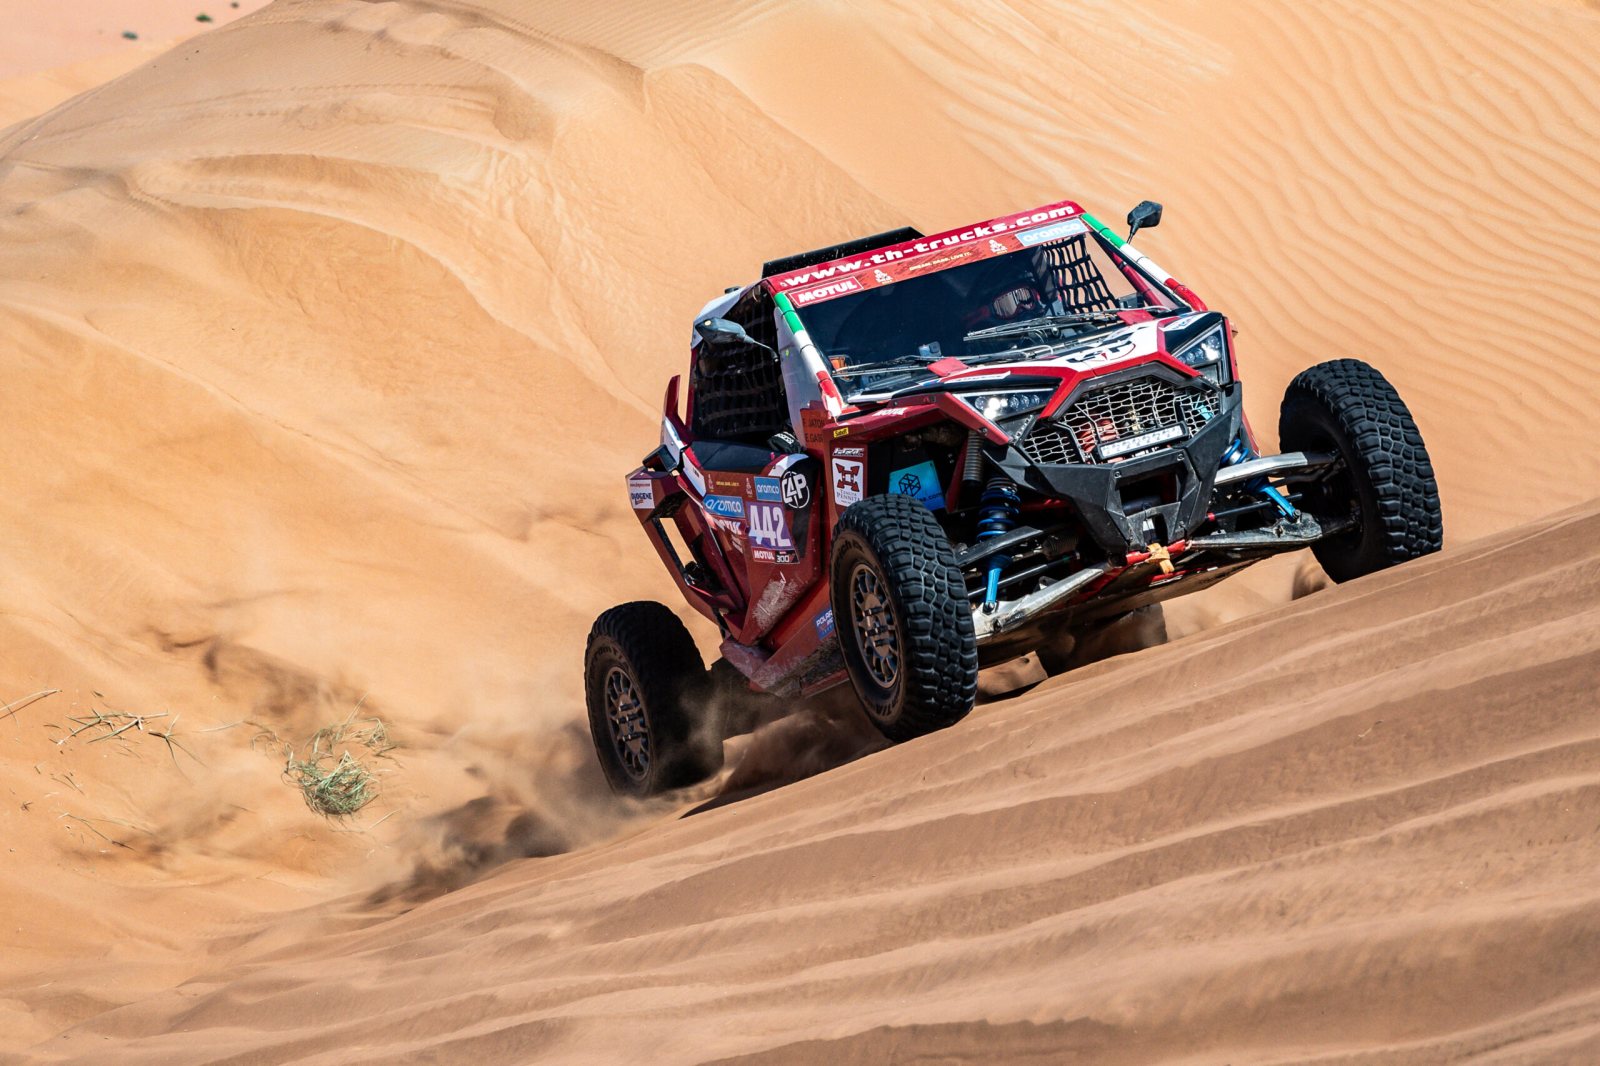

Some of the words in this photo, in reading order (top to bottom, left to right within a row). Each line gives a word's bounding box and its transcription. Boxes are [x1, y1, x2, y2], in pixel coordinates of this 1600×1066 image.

[1022, 222, 1080, 242] aramco
[784, 206, 1074, 286] www.th-trucks.com
[798, 280, 858, 303] MOTUL
[757, 484, 780, 494] aramco
[705, 499, 742, 513] aramco
[748, 505, 792, 547] 442
[754, 550, 775, 560] MOTUL
[816, 609, 833, 627] POLAR
